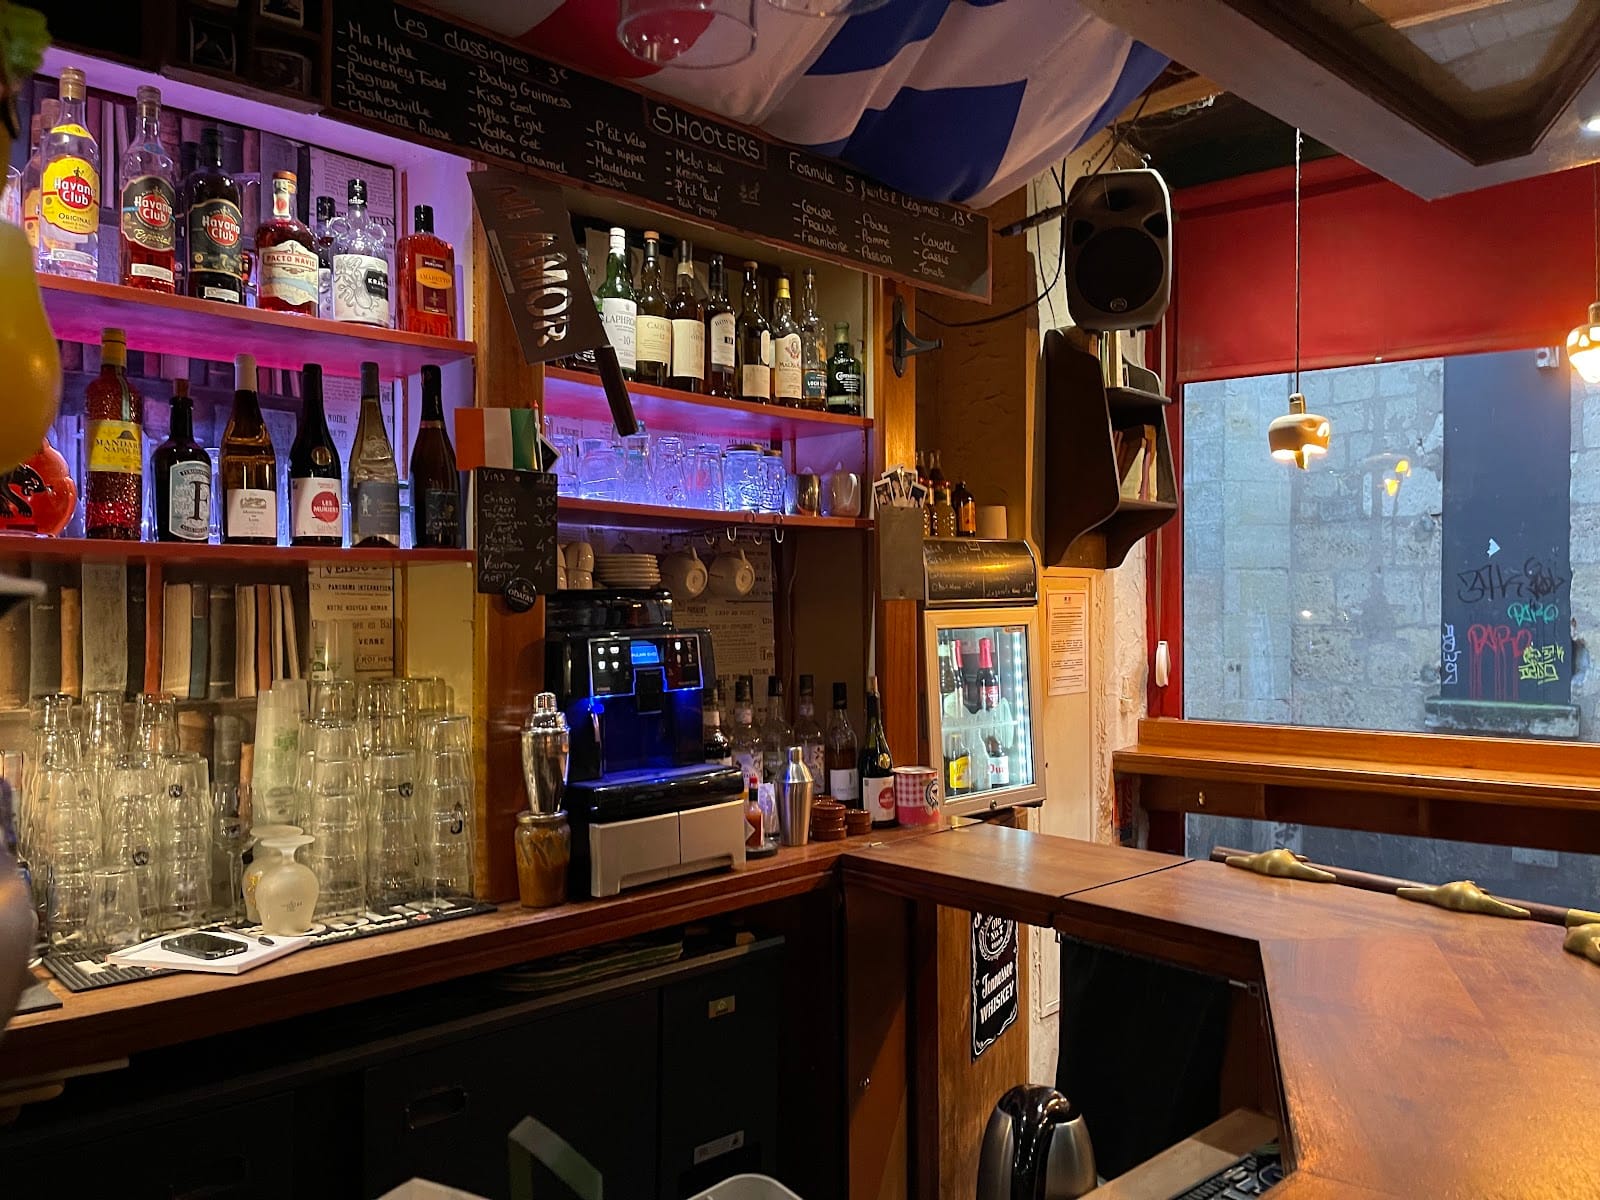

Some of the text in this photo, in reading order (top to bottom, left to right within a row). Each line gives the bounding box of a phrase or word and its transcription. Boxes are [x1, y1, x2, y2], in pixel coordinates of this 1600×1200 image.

[393, 8, 428, 38] Les
[346, 44, 447, 91] Sweeney Todd
[347, 61, 402, 94] Ragnar
[476, 85, 503, 107] Kiss
[477, 64, 572, 109] Baby Guinness
[346, 80, 432, 118] Baskerville
[513, 114, 545, 136] Eight
[477, 122, 541, 150] Vodka Get
[477, 136, 568, 174] Vodka Caramel
[594, 139, 614, 156] The
[594, 156, 646, 182] Madeleine
[675, 148, 704, 169] Melon
[54, 178, 96, 196] Havana
[845, 175, 855, 192] 5
[62, 190, 89, 206] Club
[134, 196, 172, 214] Havana
[143, 208, 167, 223] Club
[202, 216, 240, 234] Havana
[211, 229, 234, 241] Club
[266, 254, 292, 263] PACTO
[861, 245, 894, 264] Passion
[922, 249, 950, 265] Cassis
[505, 232, 573, 348] AMOR
[991, 917, 1002, 930] Old
[981, 961, 1014, 999] Tennessee
[979, 979, 1015, 1025] WHISKEY
